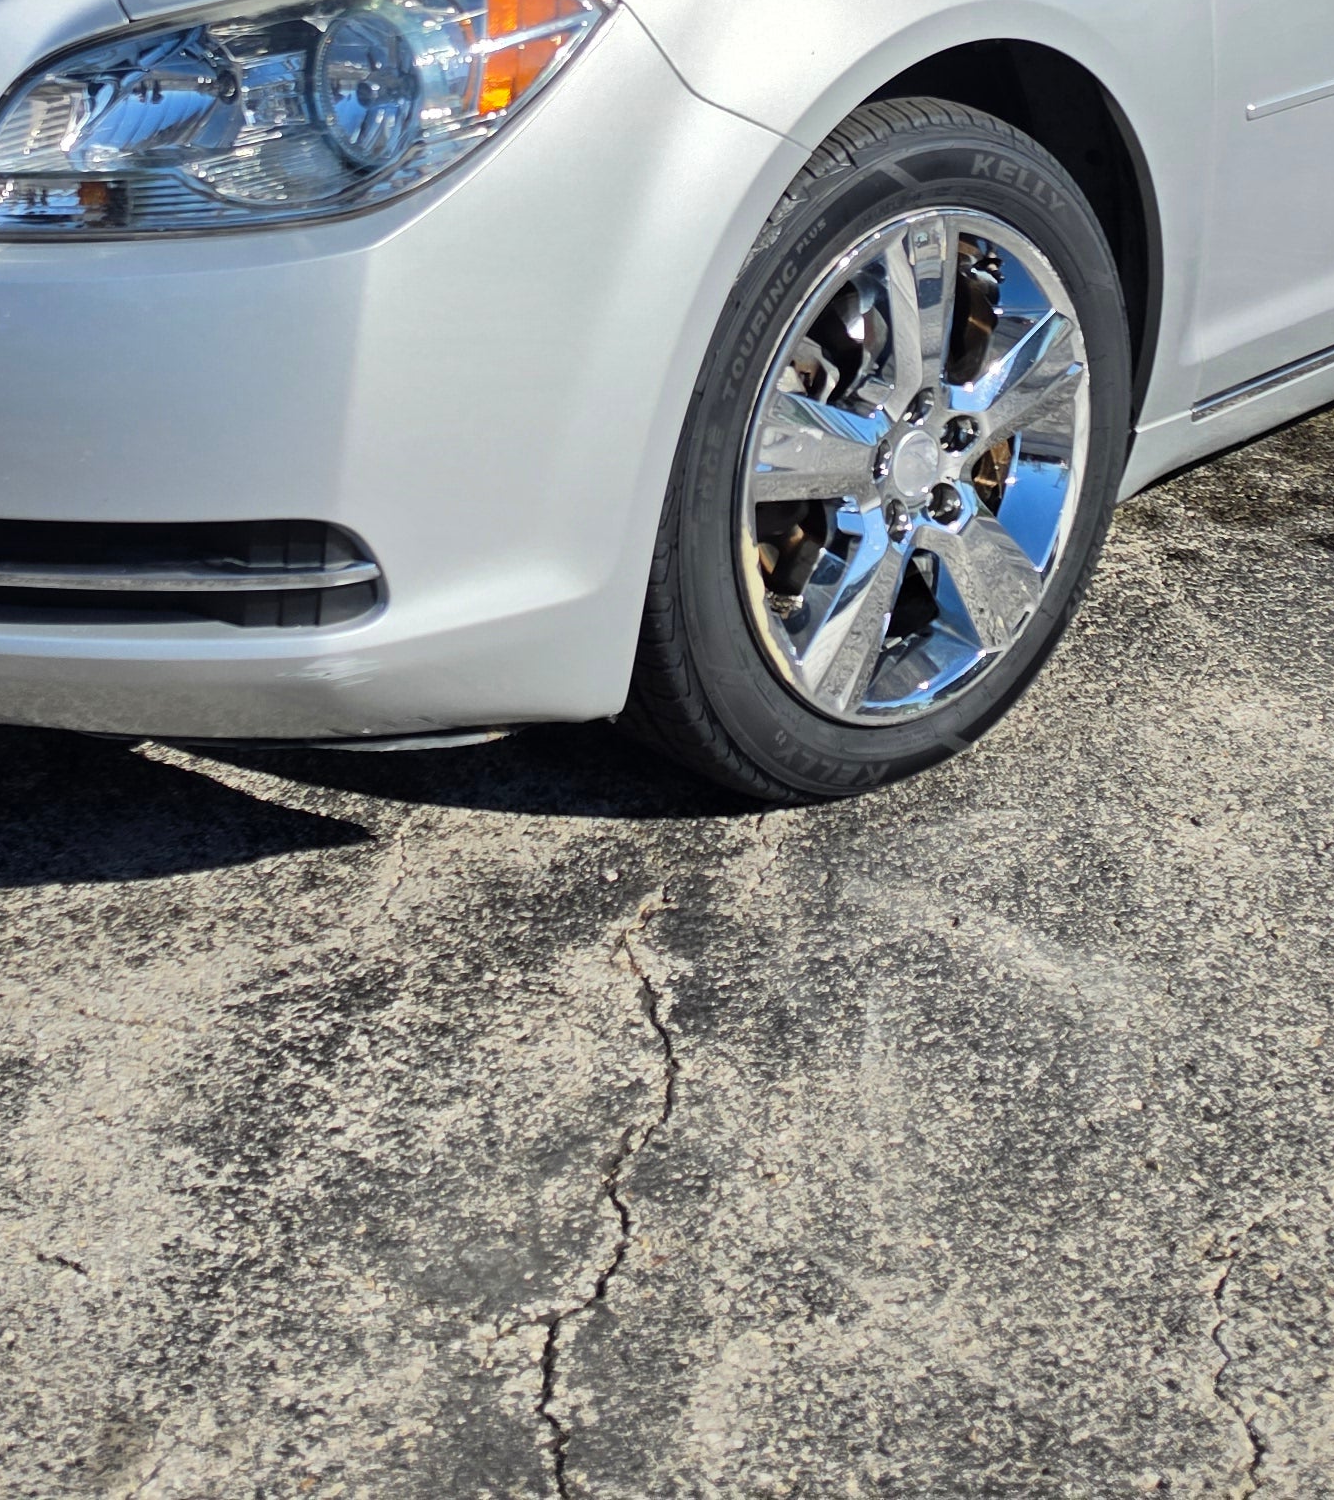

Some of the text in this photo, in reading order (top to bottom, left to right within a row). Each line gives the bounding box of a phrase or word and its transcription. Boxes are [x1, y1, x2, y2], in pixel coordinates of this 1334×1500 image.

[970, 152, 1067, 212] KELLY
[721, 217, 828, 400] TOURING PLUS
